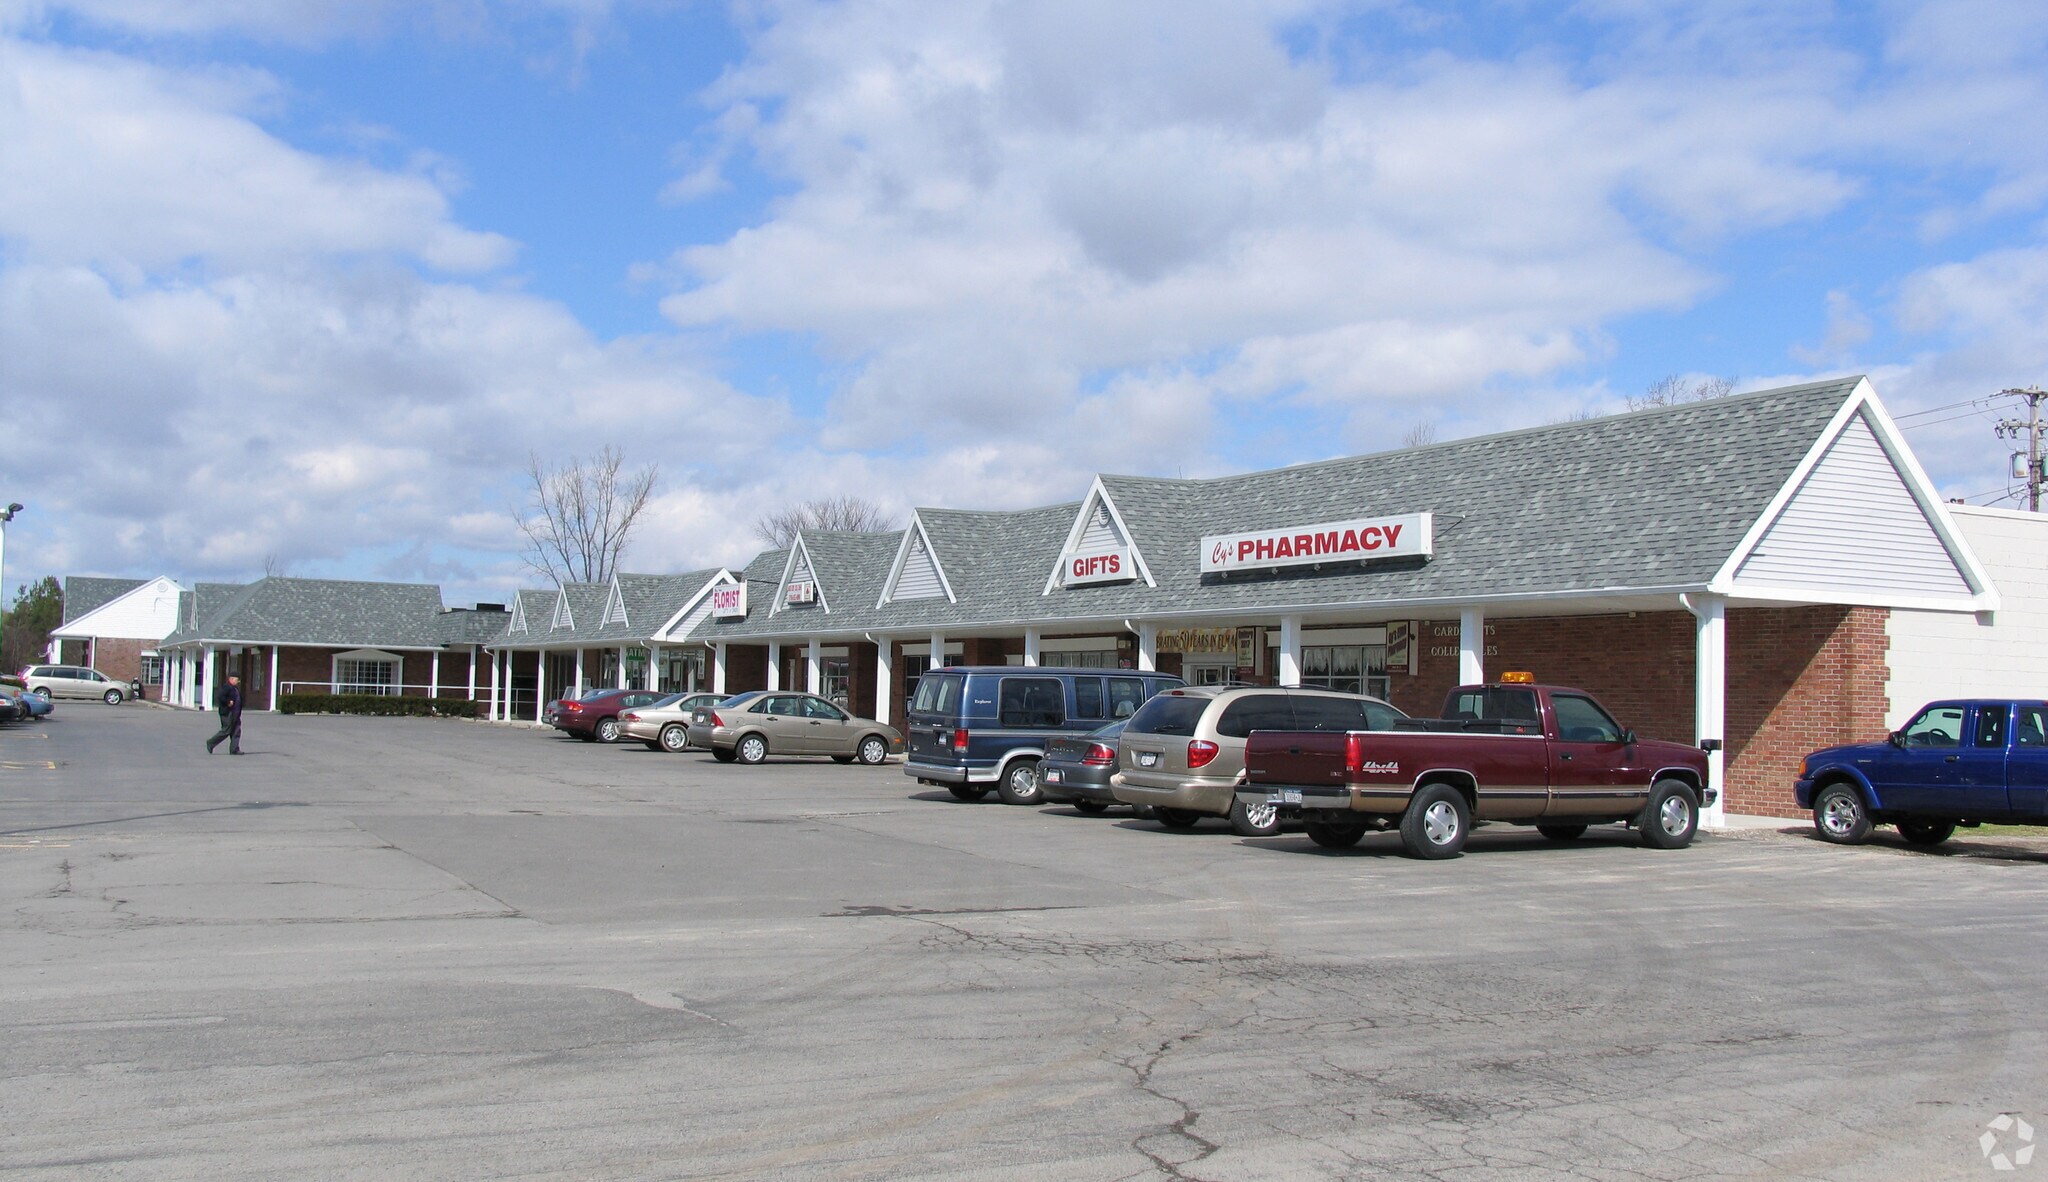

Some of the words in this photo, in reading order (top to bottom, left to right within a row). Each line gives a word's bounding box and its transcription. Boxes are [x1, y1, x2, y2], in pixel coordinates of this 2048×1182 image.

[1212, 541, 1234, 565] Cy's
[1238, 524, 1403, 562] PHARMACY
[1073, 554, 1120, 577] GIFTS
[714, 590, 740, 609] FLORIST
[1434, 626, 1461, 637] CARD
[628, 648, 644, 657] ATM
[1362, 761, 1399, 774] 4x4
